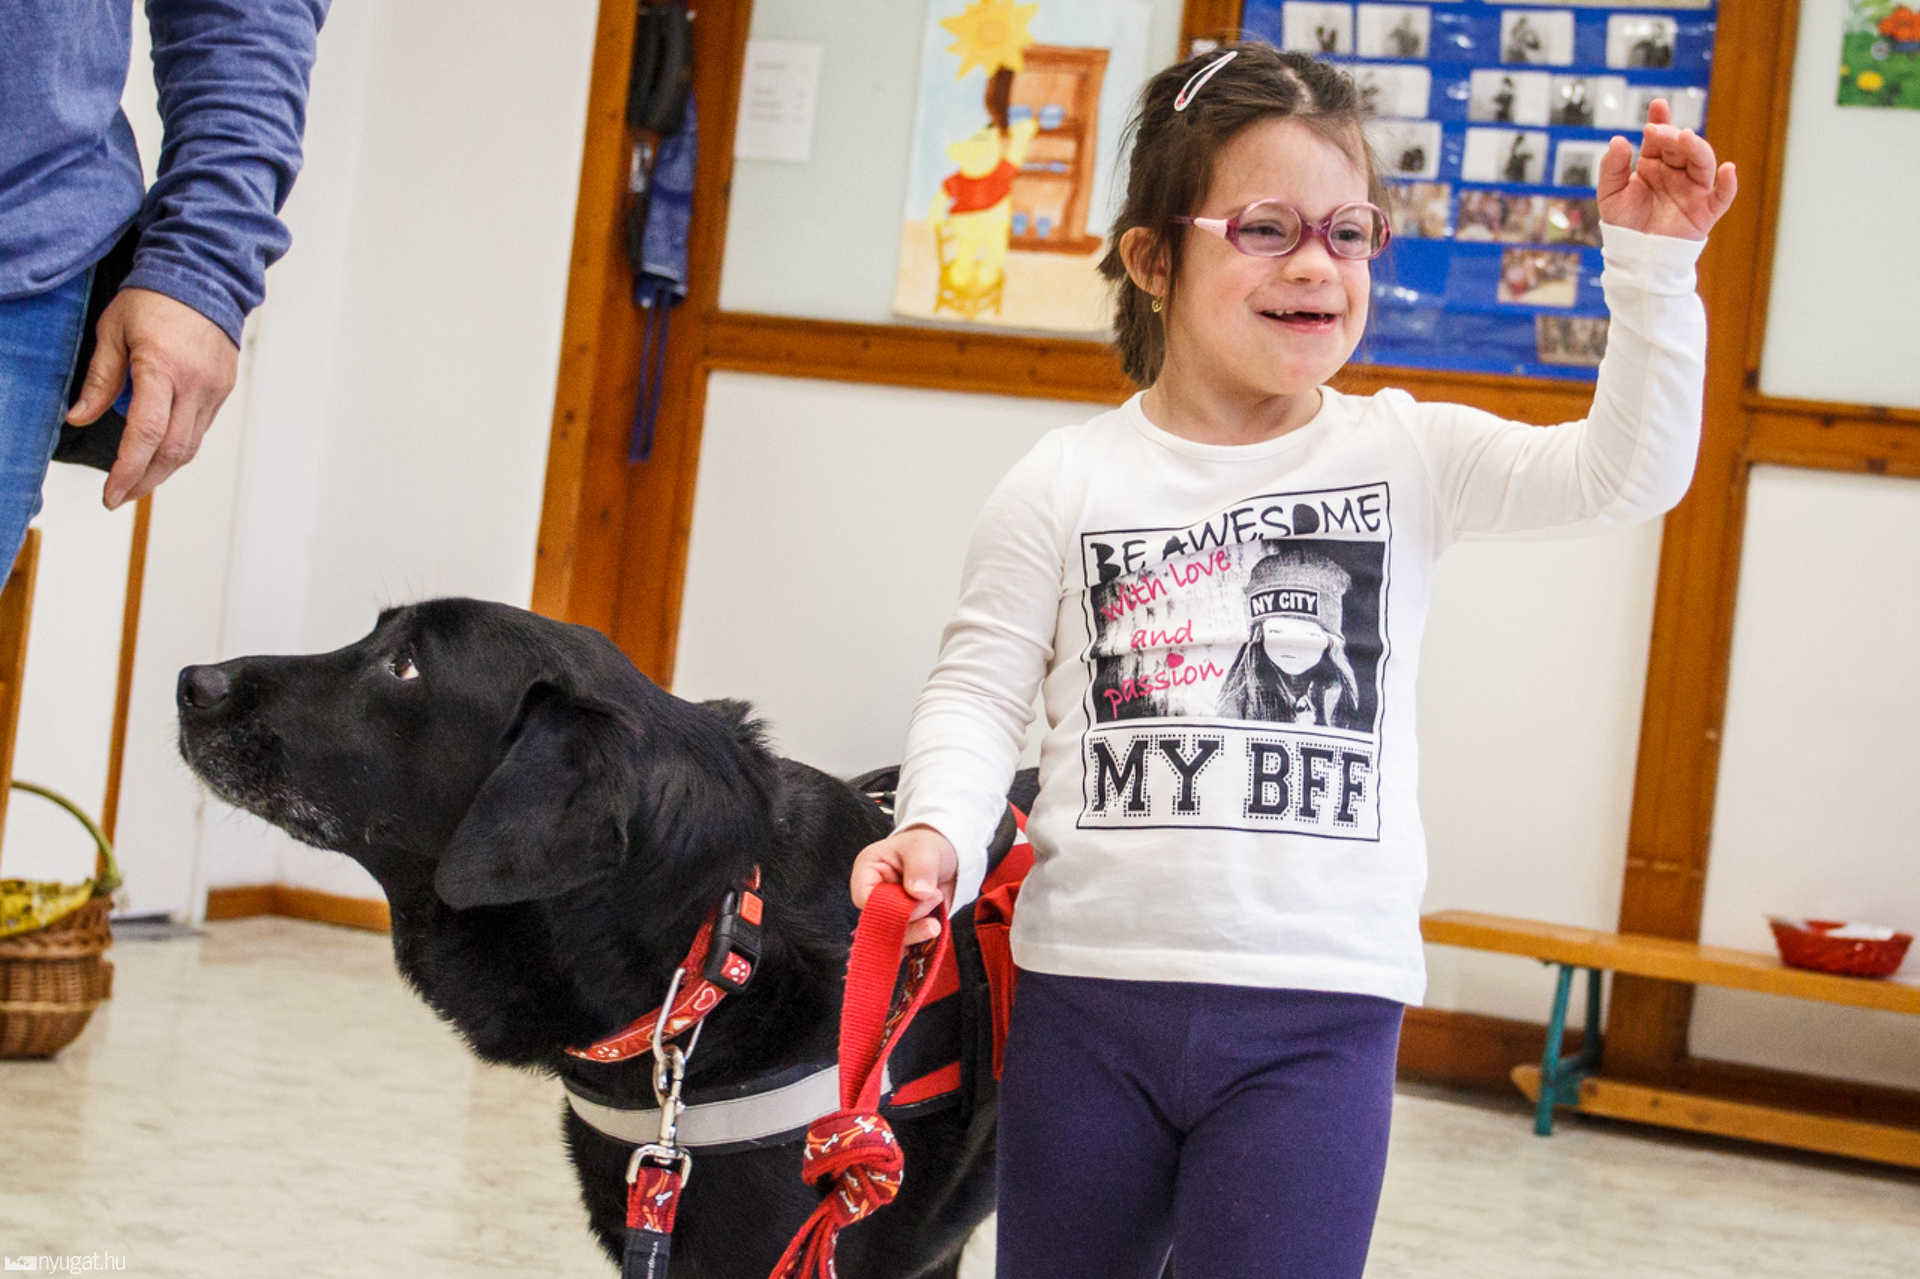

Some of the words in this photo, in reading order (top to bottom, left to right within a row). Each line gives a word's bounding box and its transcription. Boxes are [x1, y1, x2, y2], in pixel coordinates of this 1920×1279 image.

[1090, 540, 1147, 582] BE
[1161, 494, 1381, 560] AWESOME
[1101, 575, 1168, 622] with
[1251, 593, 1275, 615] NY
[1279, 591, 1317, 611] CITY
[1130, 620, 1193, 650] and
[1103, 653, 1224, 719] passion
[1088, 734, 1224, 817] MY
[1243, 737, 1373, 828] BFF
